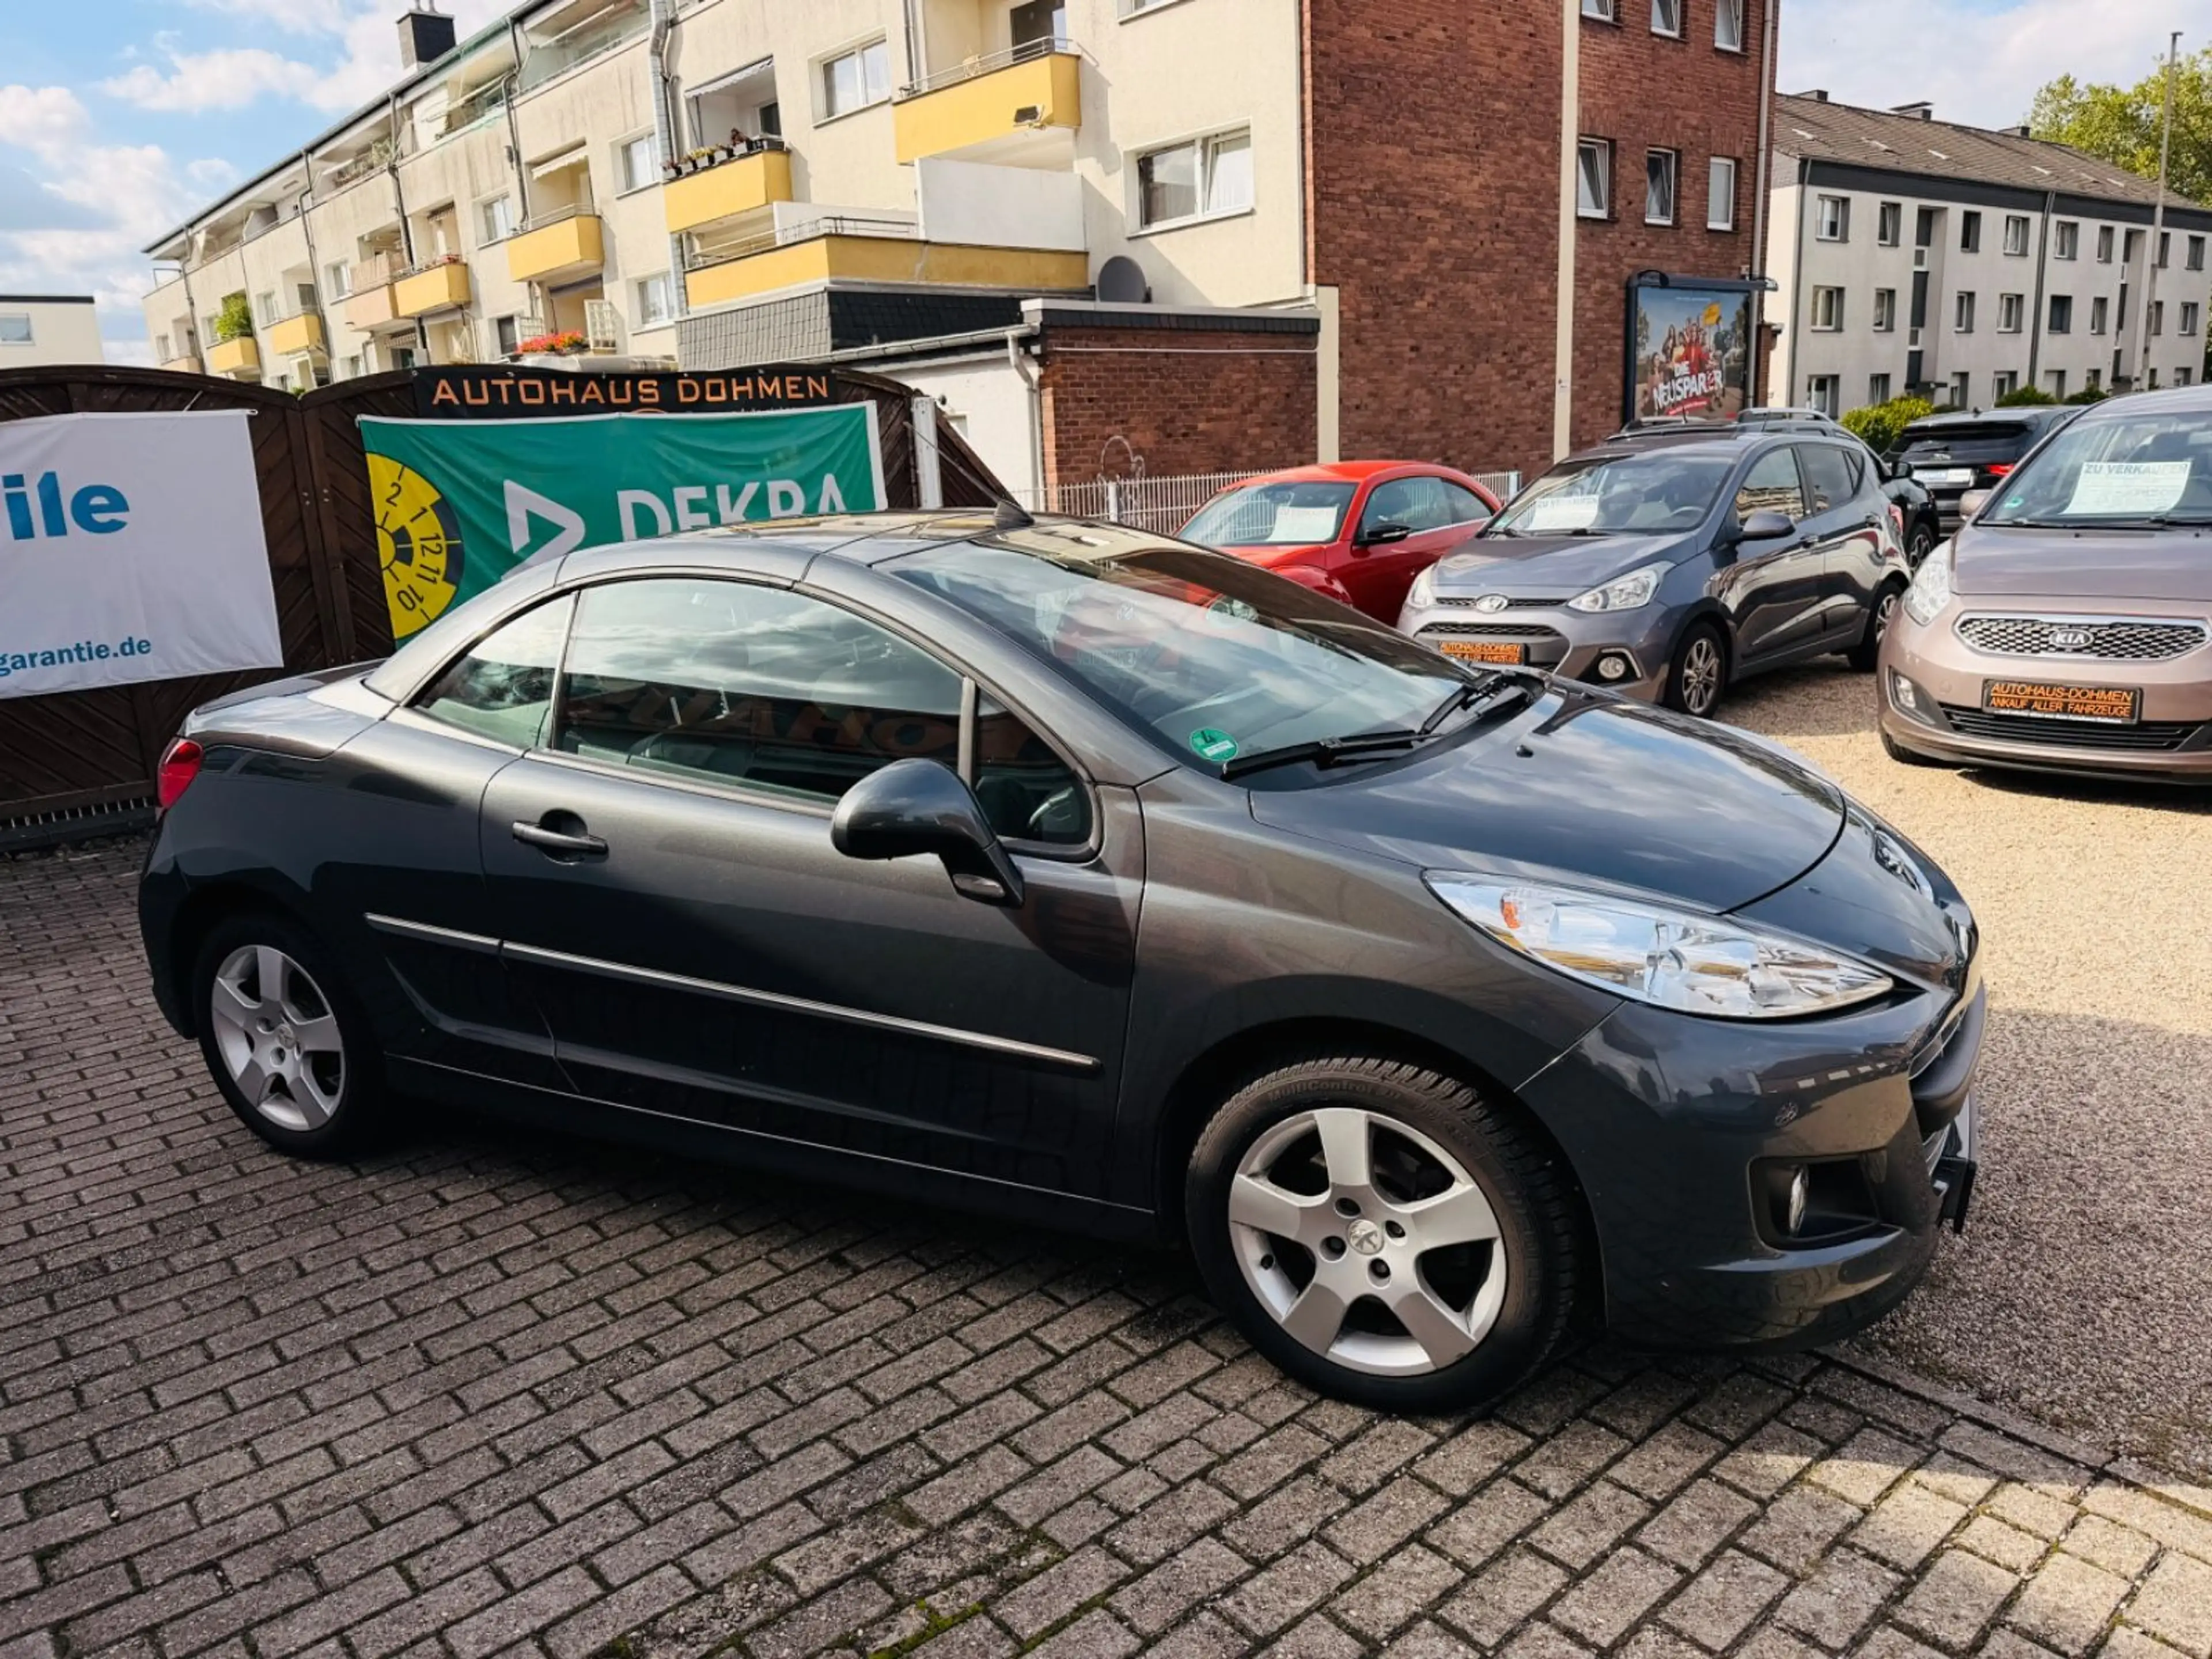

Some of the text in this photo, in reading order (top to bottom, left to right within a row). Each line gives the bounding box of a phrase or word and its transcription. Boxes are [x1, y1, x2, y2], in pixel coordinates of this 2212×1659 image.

[432, 376, 828, 405] AUTOHAUS DOHMEN
[2, 471, 130, 540] ile
[385, 482, 402, 507] 2
[617, 473, 847, 541] DEKRA
[2055, 632, 2085, 644] KIA
[2031, 699, 2063, 711] ALLER
[2067, 702, 2131, 717] FAHRZEUGE
